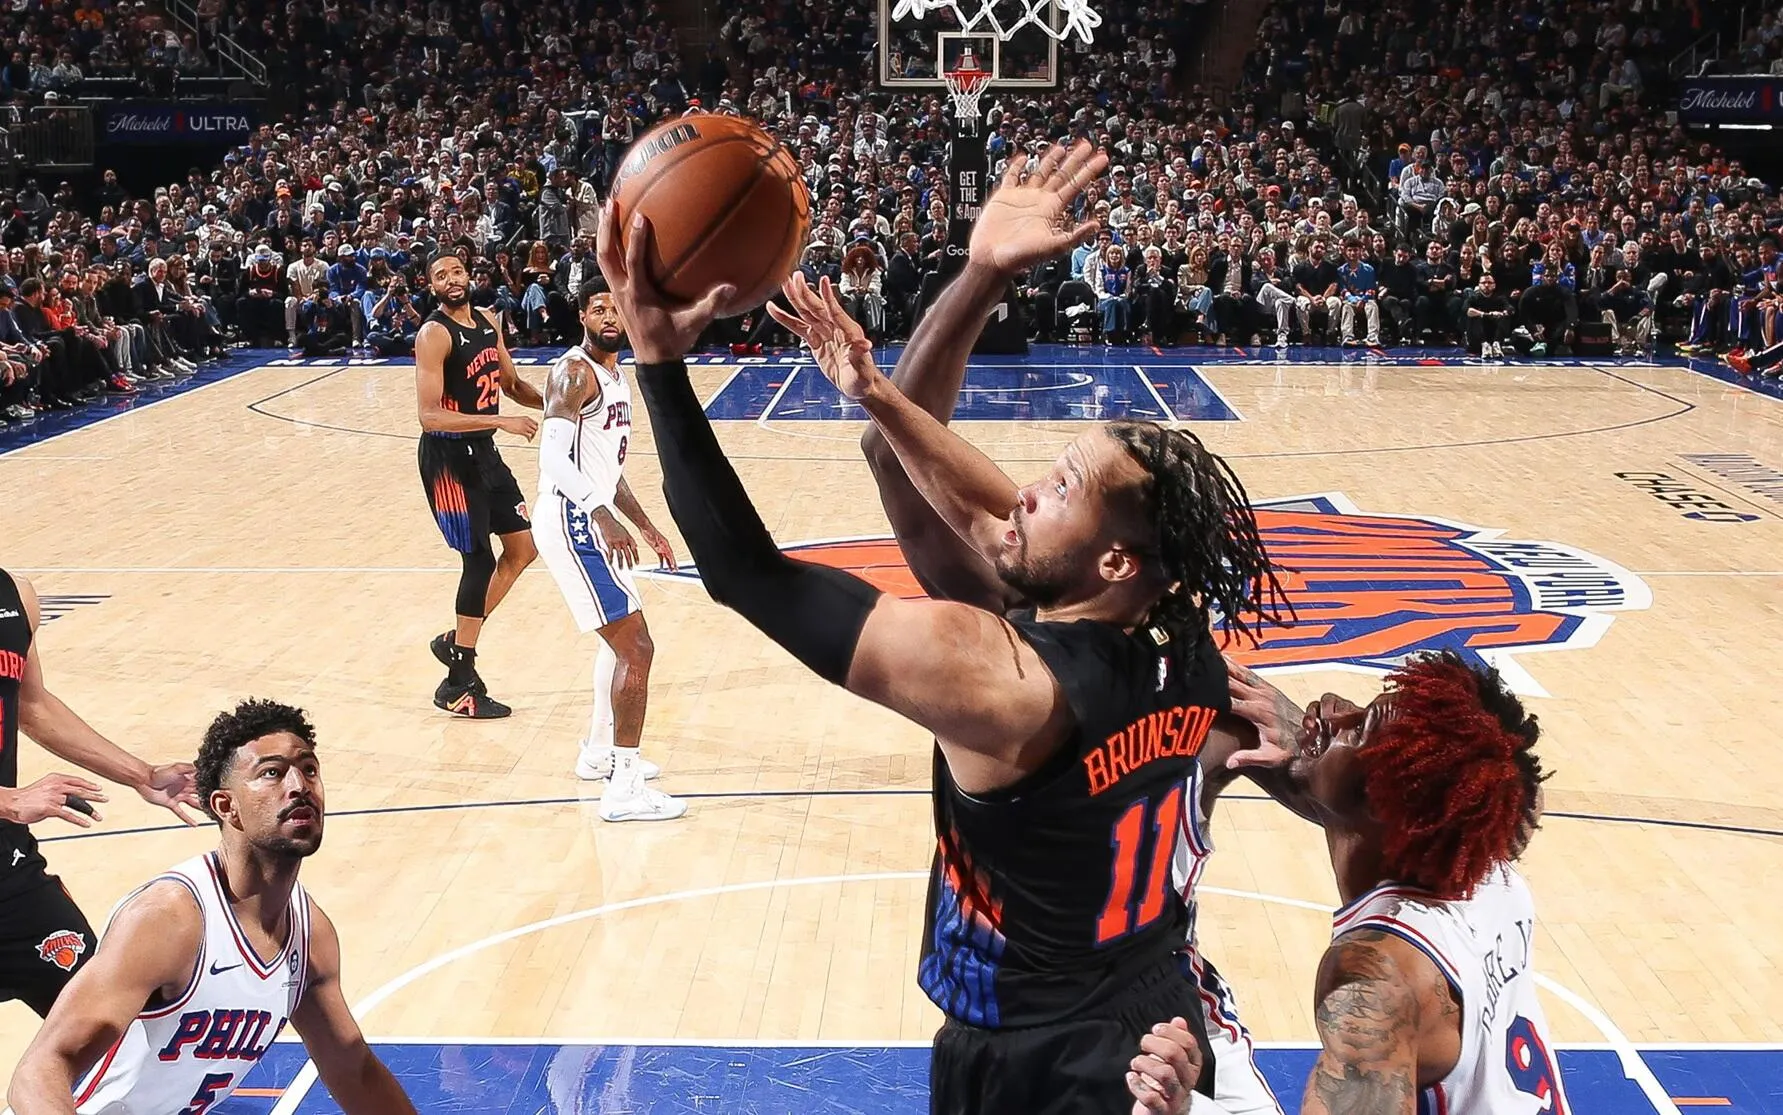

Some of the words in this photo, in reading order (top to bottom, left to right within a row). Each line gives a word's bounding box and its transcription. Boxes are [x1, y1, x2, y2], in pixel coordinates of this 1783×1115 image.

[1680, 87, 1756, 110] Michelob
[189, 116, 250, 131] ULTRA
[959, 171, 978, 187] GET
[959, 187, 978, 202] THE
[476, 370, 500, 411] 25
[617, 435, 628, 465] 8
[1613, 472, 1733, 509] CHASE
[1463, 541, 1600, 569] NEW
[1205, 508, 1567, 668] KNICKS
[1526, 572, 1625, 609] YORK
[1083, 705, 1217, 796] BRUNSON
[1096, 781, 1186, 947] 11
[1505, 1014, 1566, 1115] 9
[178, 1072, 234, 1115] 5
